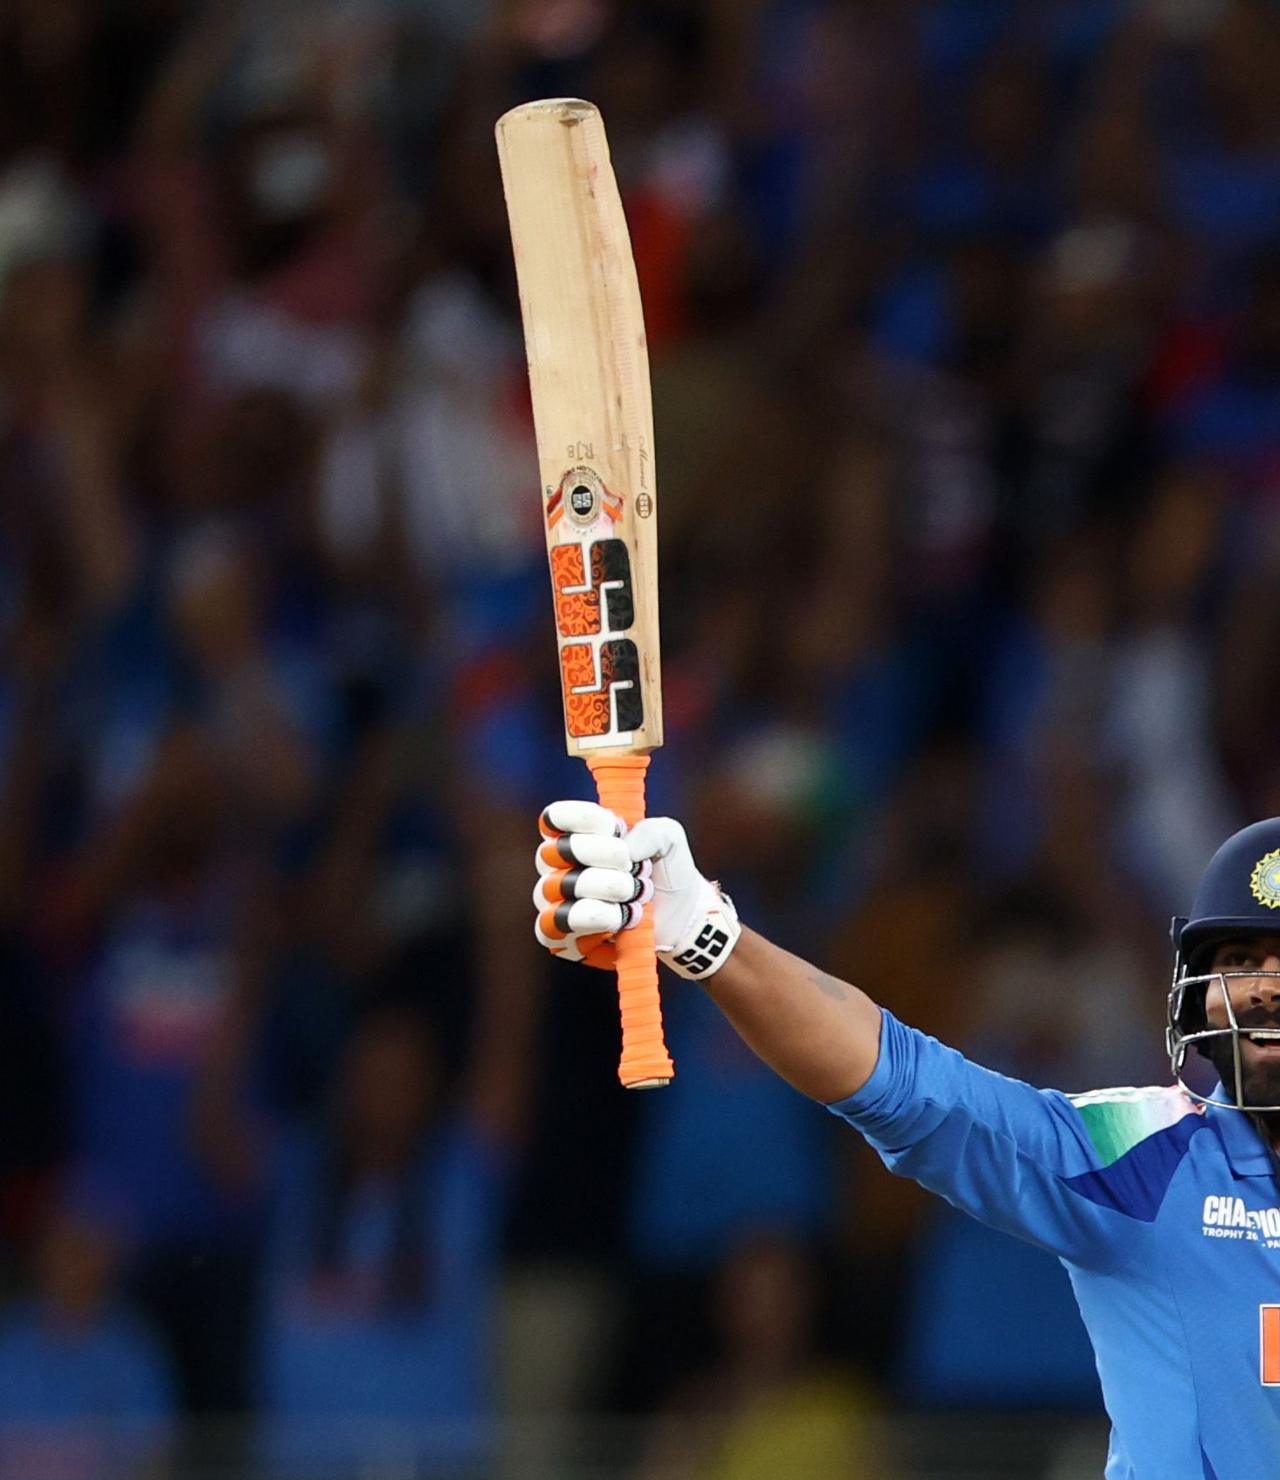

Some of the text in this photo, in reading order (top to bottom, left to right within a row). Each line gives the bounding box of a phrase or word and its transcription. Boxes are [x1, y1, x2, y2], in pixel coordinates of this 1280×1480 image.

[550, 537, 645, 739] SS
[673, 923, 729, 975] SS
[1202, 1226, 1244, 1240] TROPHY
